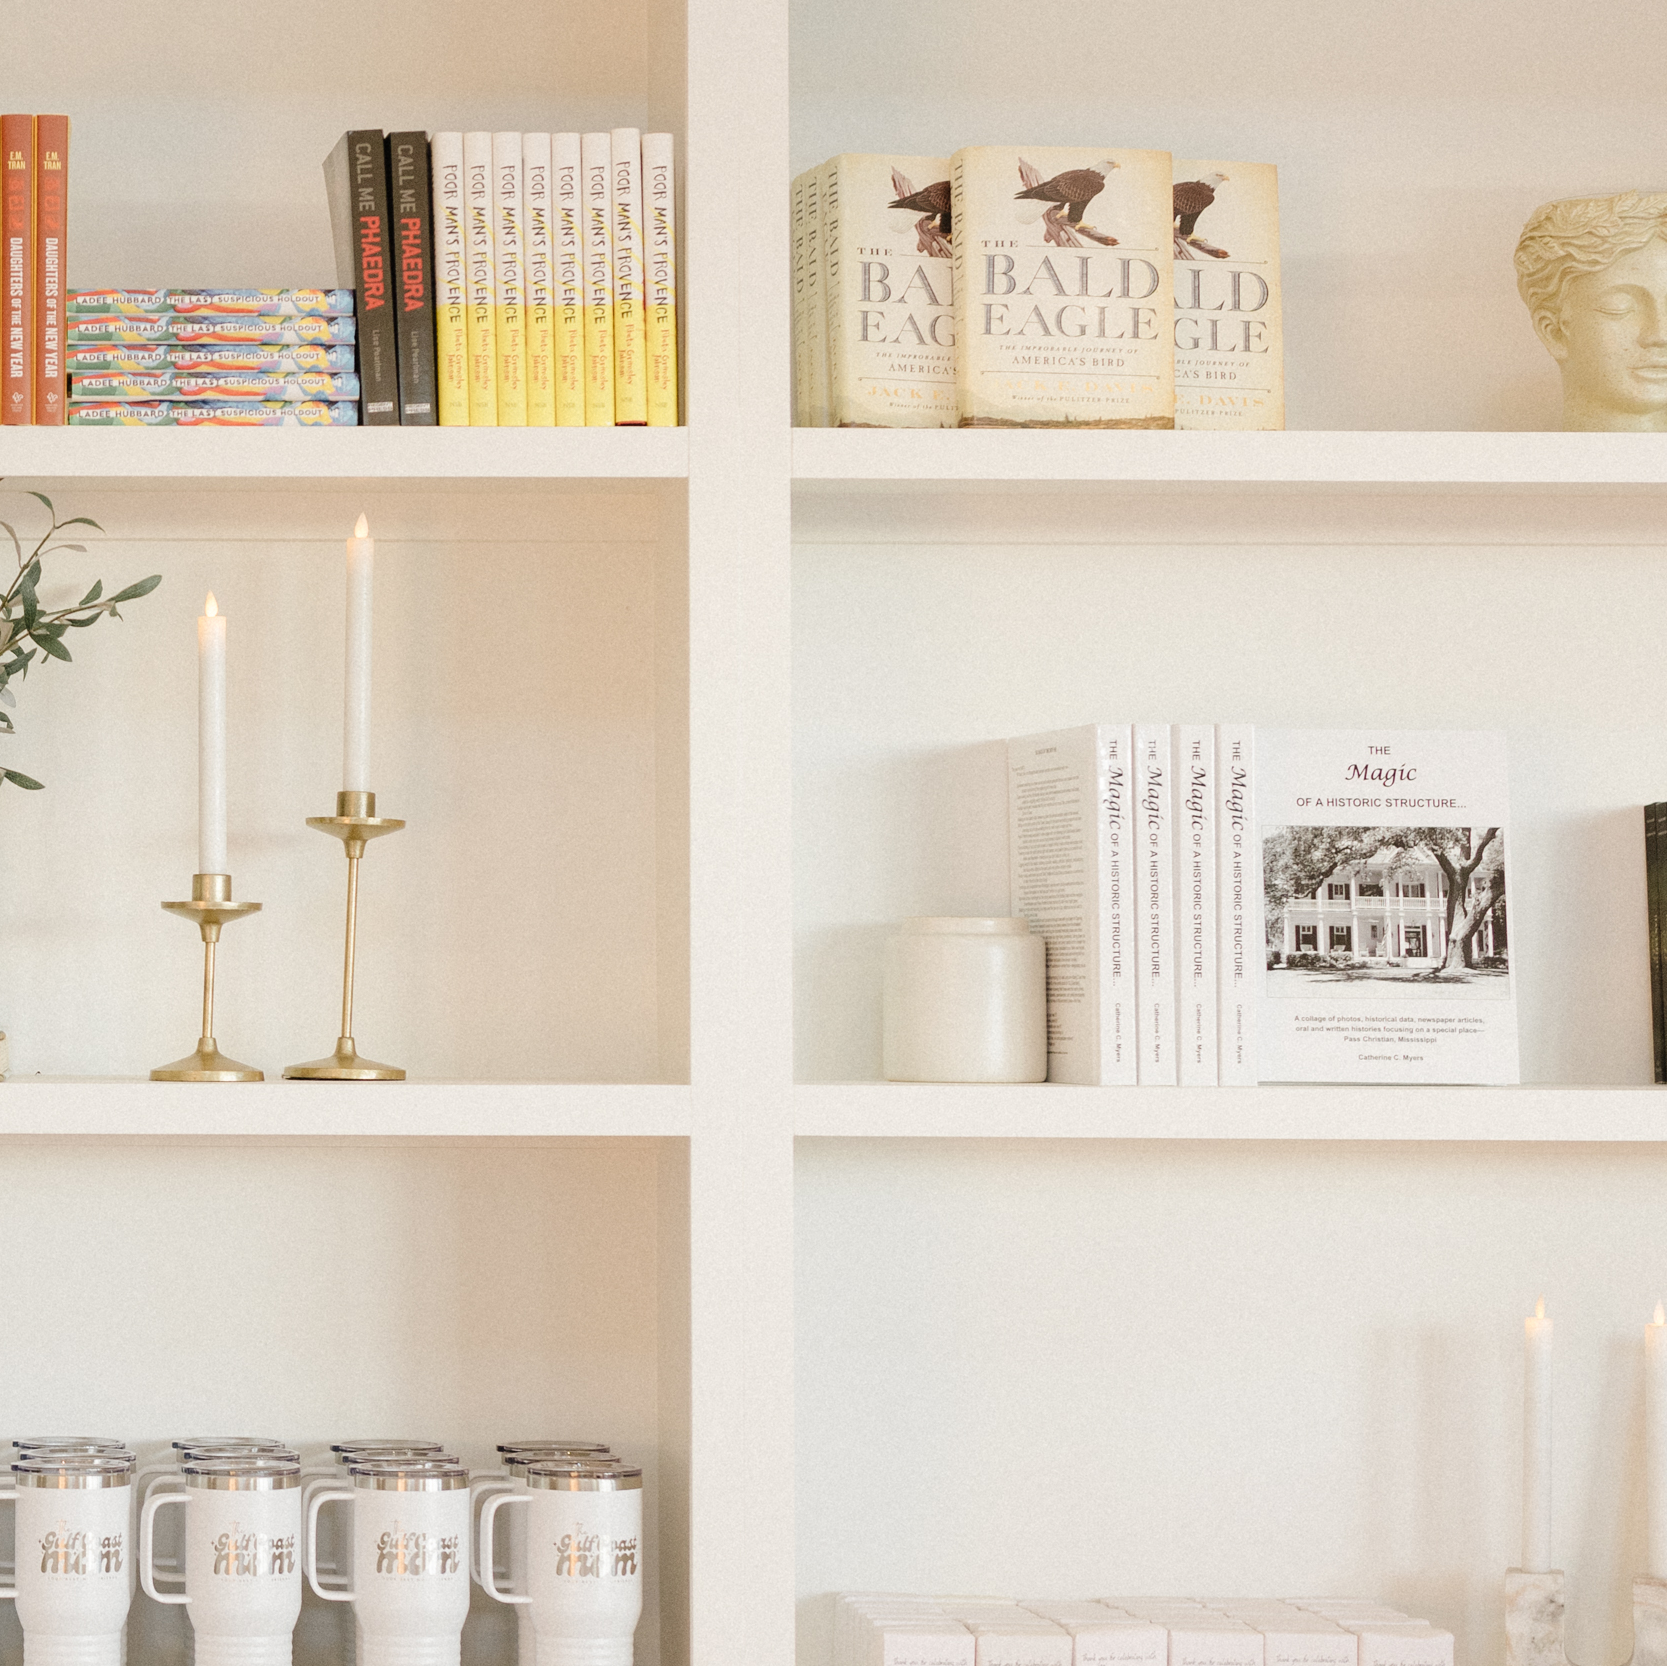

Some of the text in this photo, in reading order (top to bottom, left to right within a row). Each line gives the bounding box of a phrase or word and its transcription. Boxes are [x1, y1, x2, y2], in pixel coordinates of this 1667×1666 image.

[355, 143, 385, 311] CALL ME PHAEDRA
[443, 165, 461, 324] POOR MAN'S PROVENCE
[981, 240, 1019, 248] THE
[981, 253, 1160, 299] BALD
[75, 296, 108, 304] LADEE
[112, 296, 162, 304] HUBBARD
[277, 295, 319, 303] HOLDOUT
[981, 302, 1159, 341] EAGLE
[1012, 355, 1125, 369] AMERICA'S BIRD
[1368, 746, 1390, 755] THE
[1345, 763, 1417, 787] Magic
[1296, 798, 1313, 807] OF
[1315, 798, 1324, 807] A
[1326, 798, 1382, 808] HISTORIC
[1403, 1054, 1423, 1062] Myers
